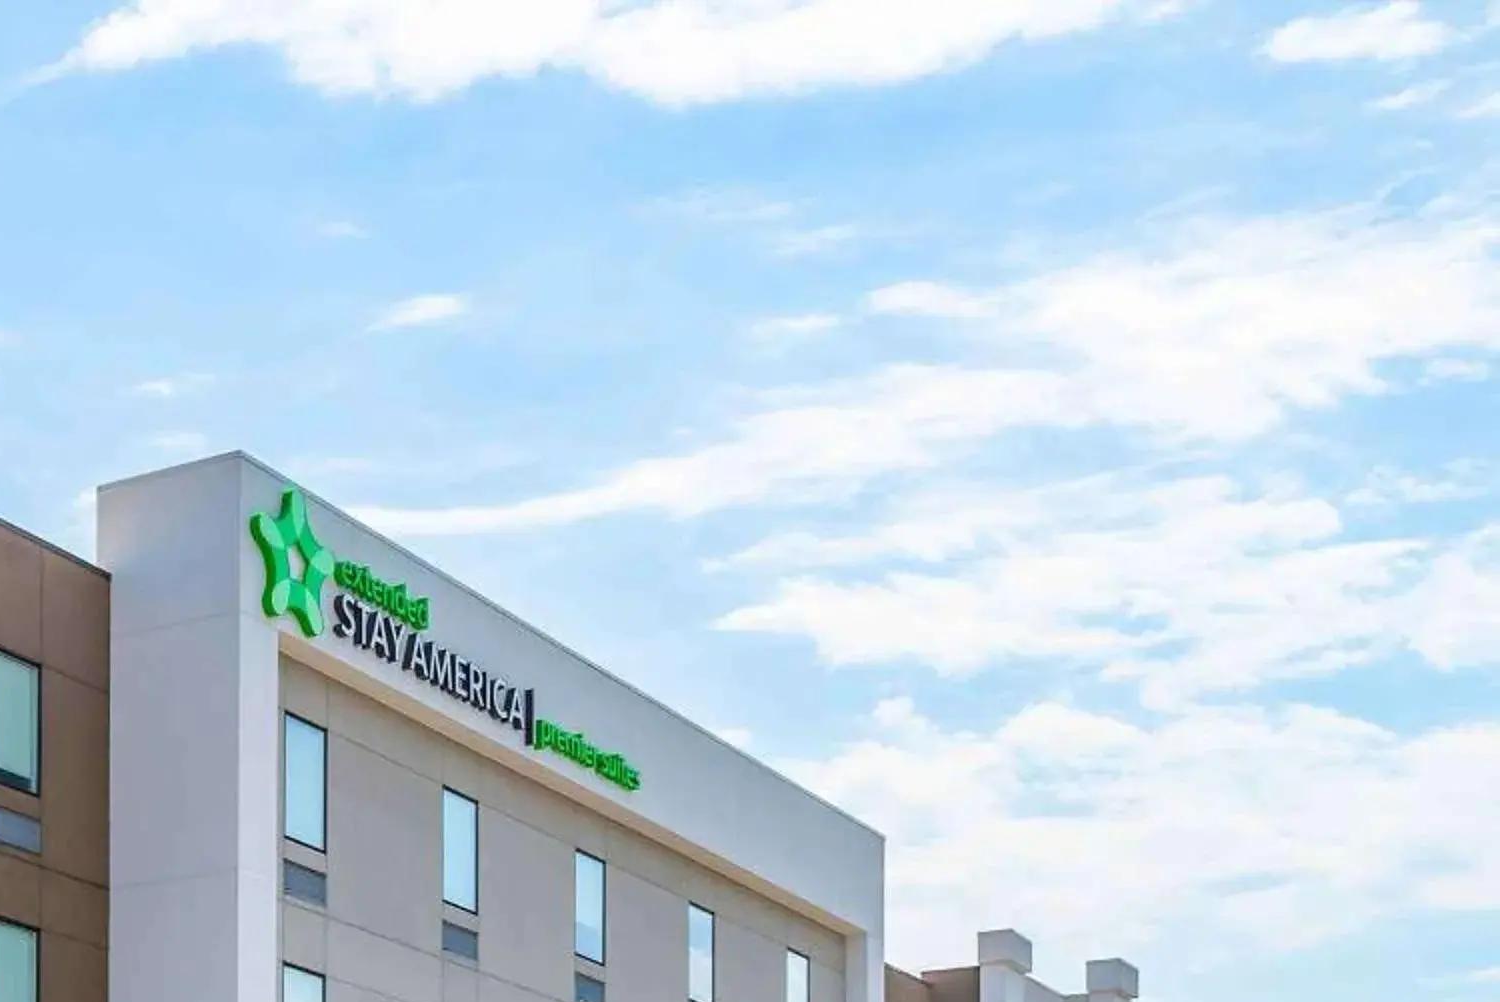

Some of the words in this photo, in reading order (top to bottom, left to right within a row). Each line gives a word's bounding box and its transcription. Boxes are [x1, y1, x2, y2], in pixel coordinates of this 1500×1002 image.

[333, 560, 430, 630] extended
[332, 594, 406, 664] STAY
[400, 630, 526, 730] AMERICA
